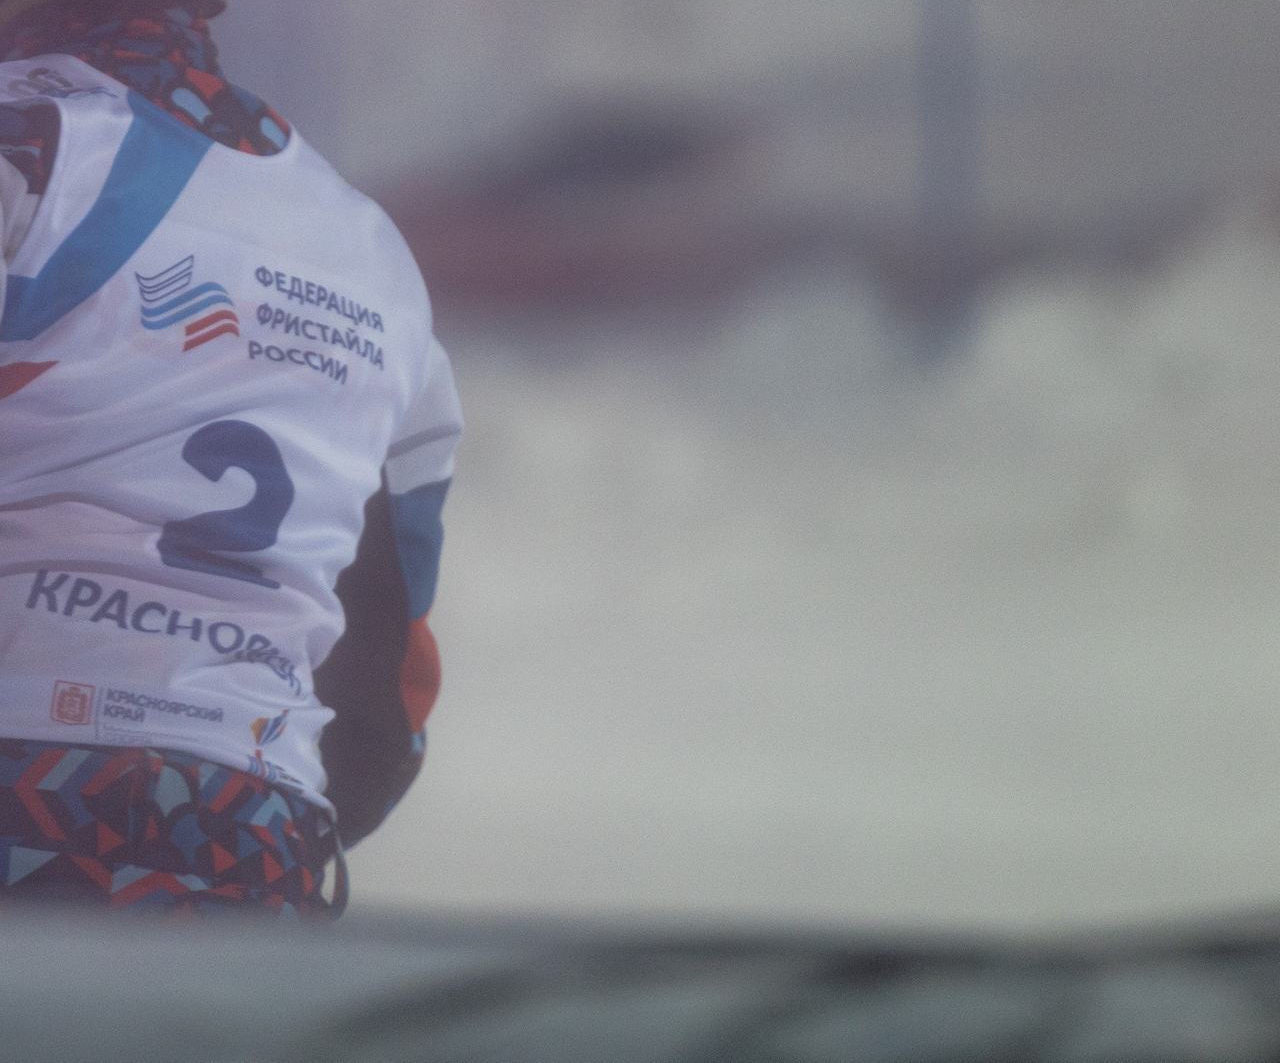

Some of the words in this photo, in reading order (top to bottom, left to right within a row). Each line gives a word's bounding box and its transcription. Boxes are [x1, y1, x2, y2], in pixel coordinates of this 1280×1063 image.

[255, 265, 385, 332] ФЕДЕРАЦИЯ
[248, 340, 349, 385] РОССИИ
[256, 302, 385, 370] ФРИСТАЙЛА
[155, 419, 296, 590] 2
[103, 703, 146, 723] КРАЙ
[106, 688, 224, 723] КРАСНОЯРСКИЙ
